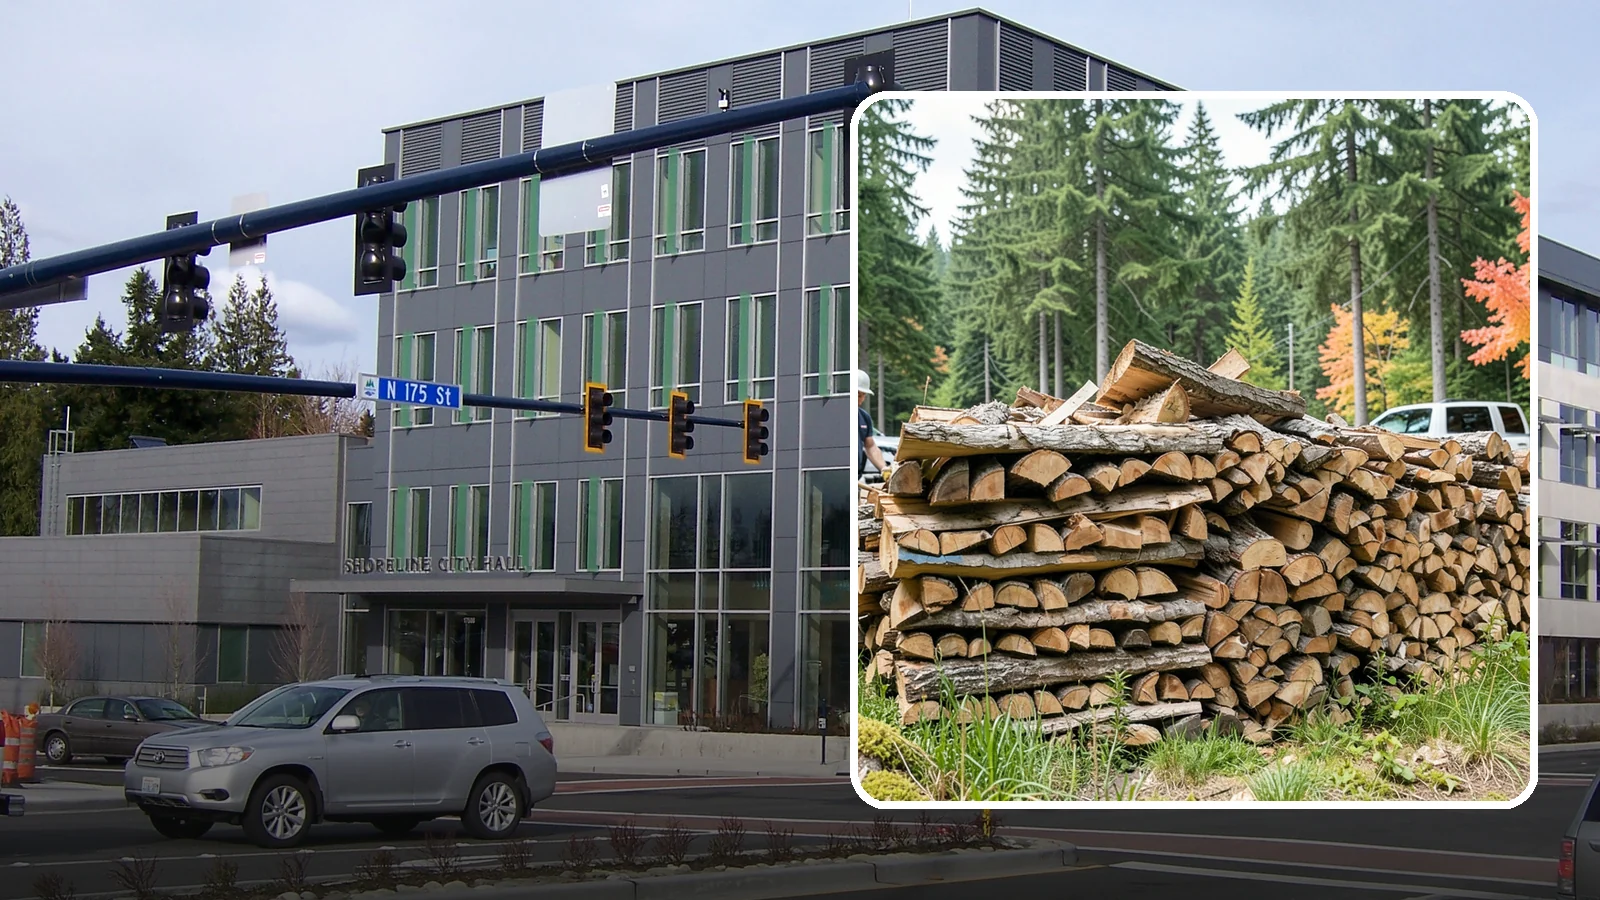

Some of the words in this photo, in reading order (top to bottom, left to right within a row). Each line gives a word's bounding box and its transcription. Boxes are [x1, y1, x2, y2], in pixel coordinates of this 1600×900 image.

[387, 380, 397, 400] N
[405, 382, 428, 403] 175
[435, 386, 452, 406] St
[343, 558, 432, 573] SHORELINE
[438, 556, 476, 571] CITY
[483, 556, 525, 571] HALL
